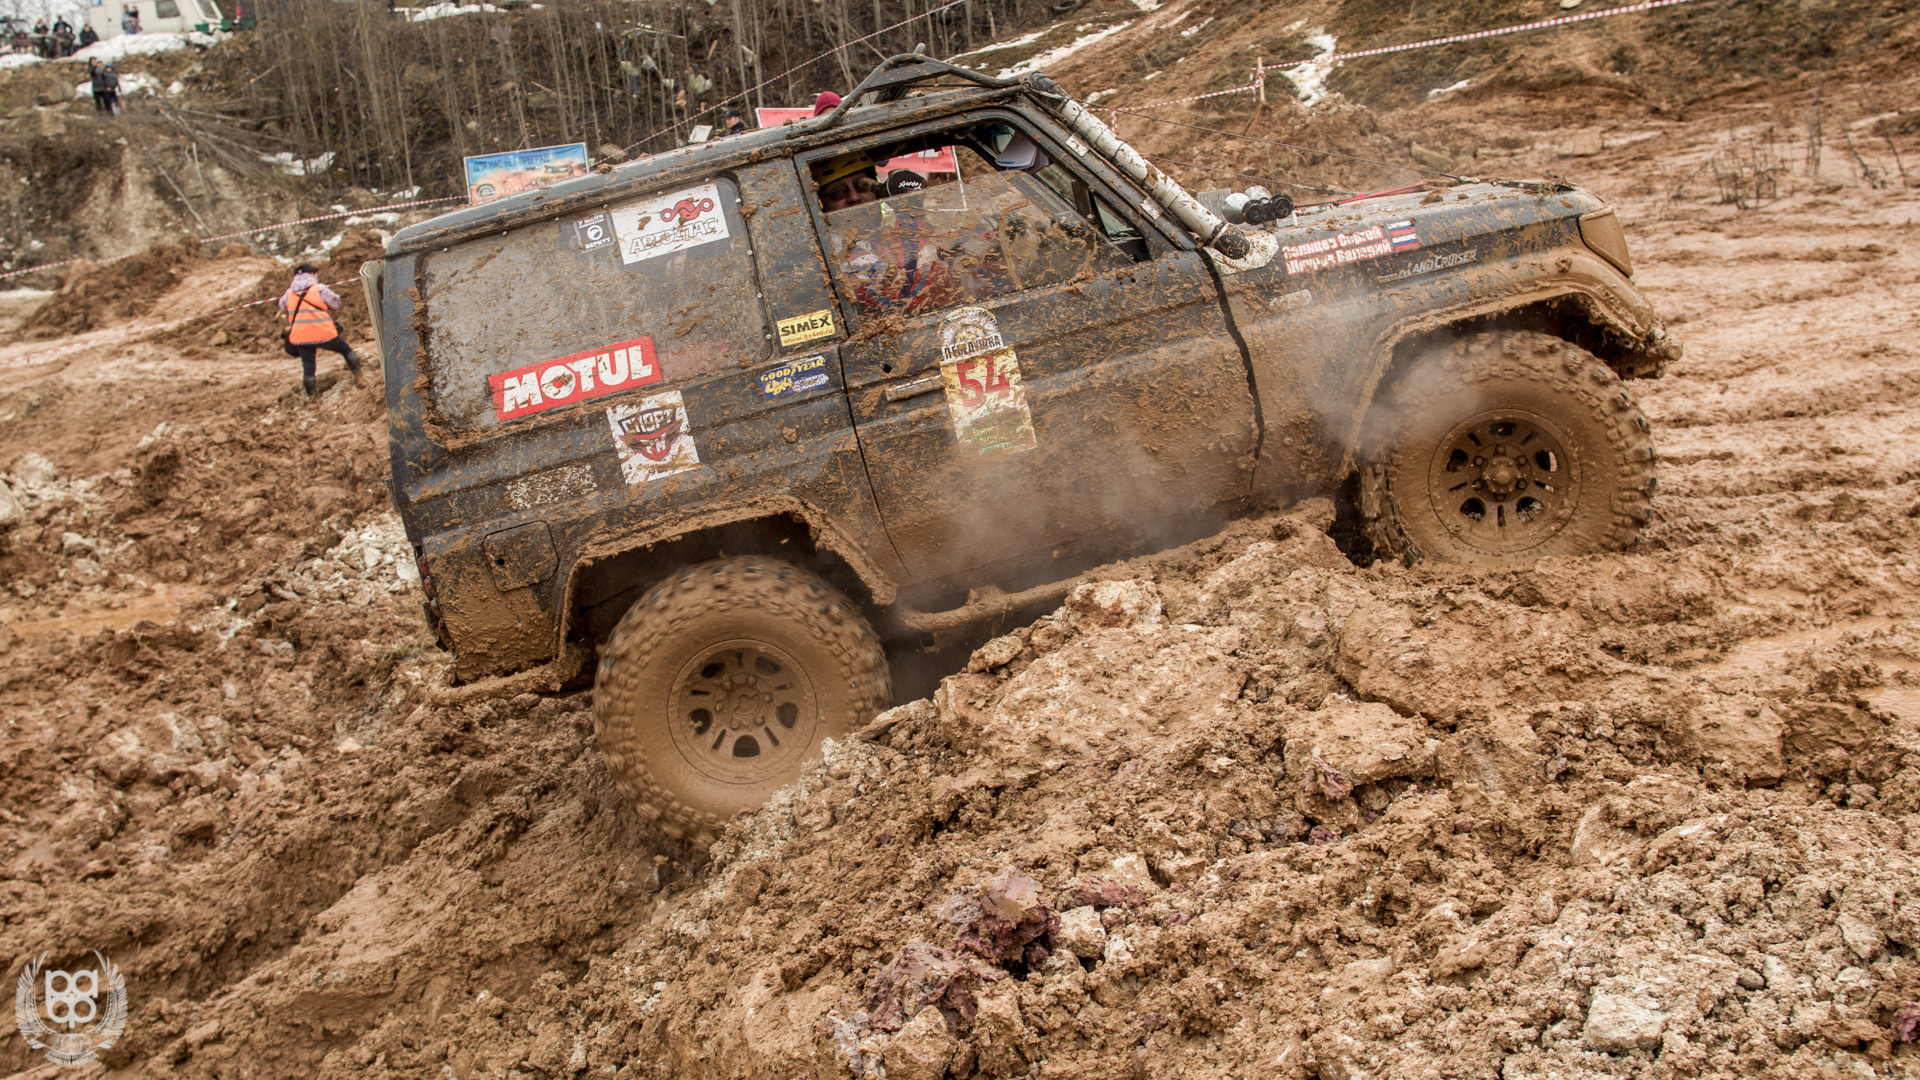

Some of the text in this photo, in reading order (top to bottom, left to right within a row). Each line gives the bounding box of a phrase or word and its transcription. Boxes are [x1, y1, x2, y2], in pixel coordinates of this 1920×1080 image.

[780, 315, 831, 338] SIMEX
[503, 344, 653, 413] MOTUL
[956, 355, 1011, 408] 54
